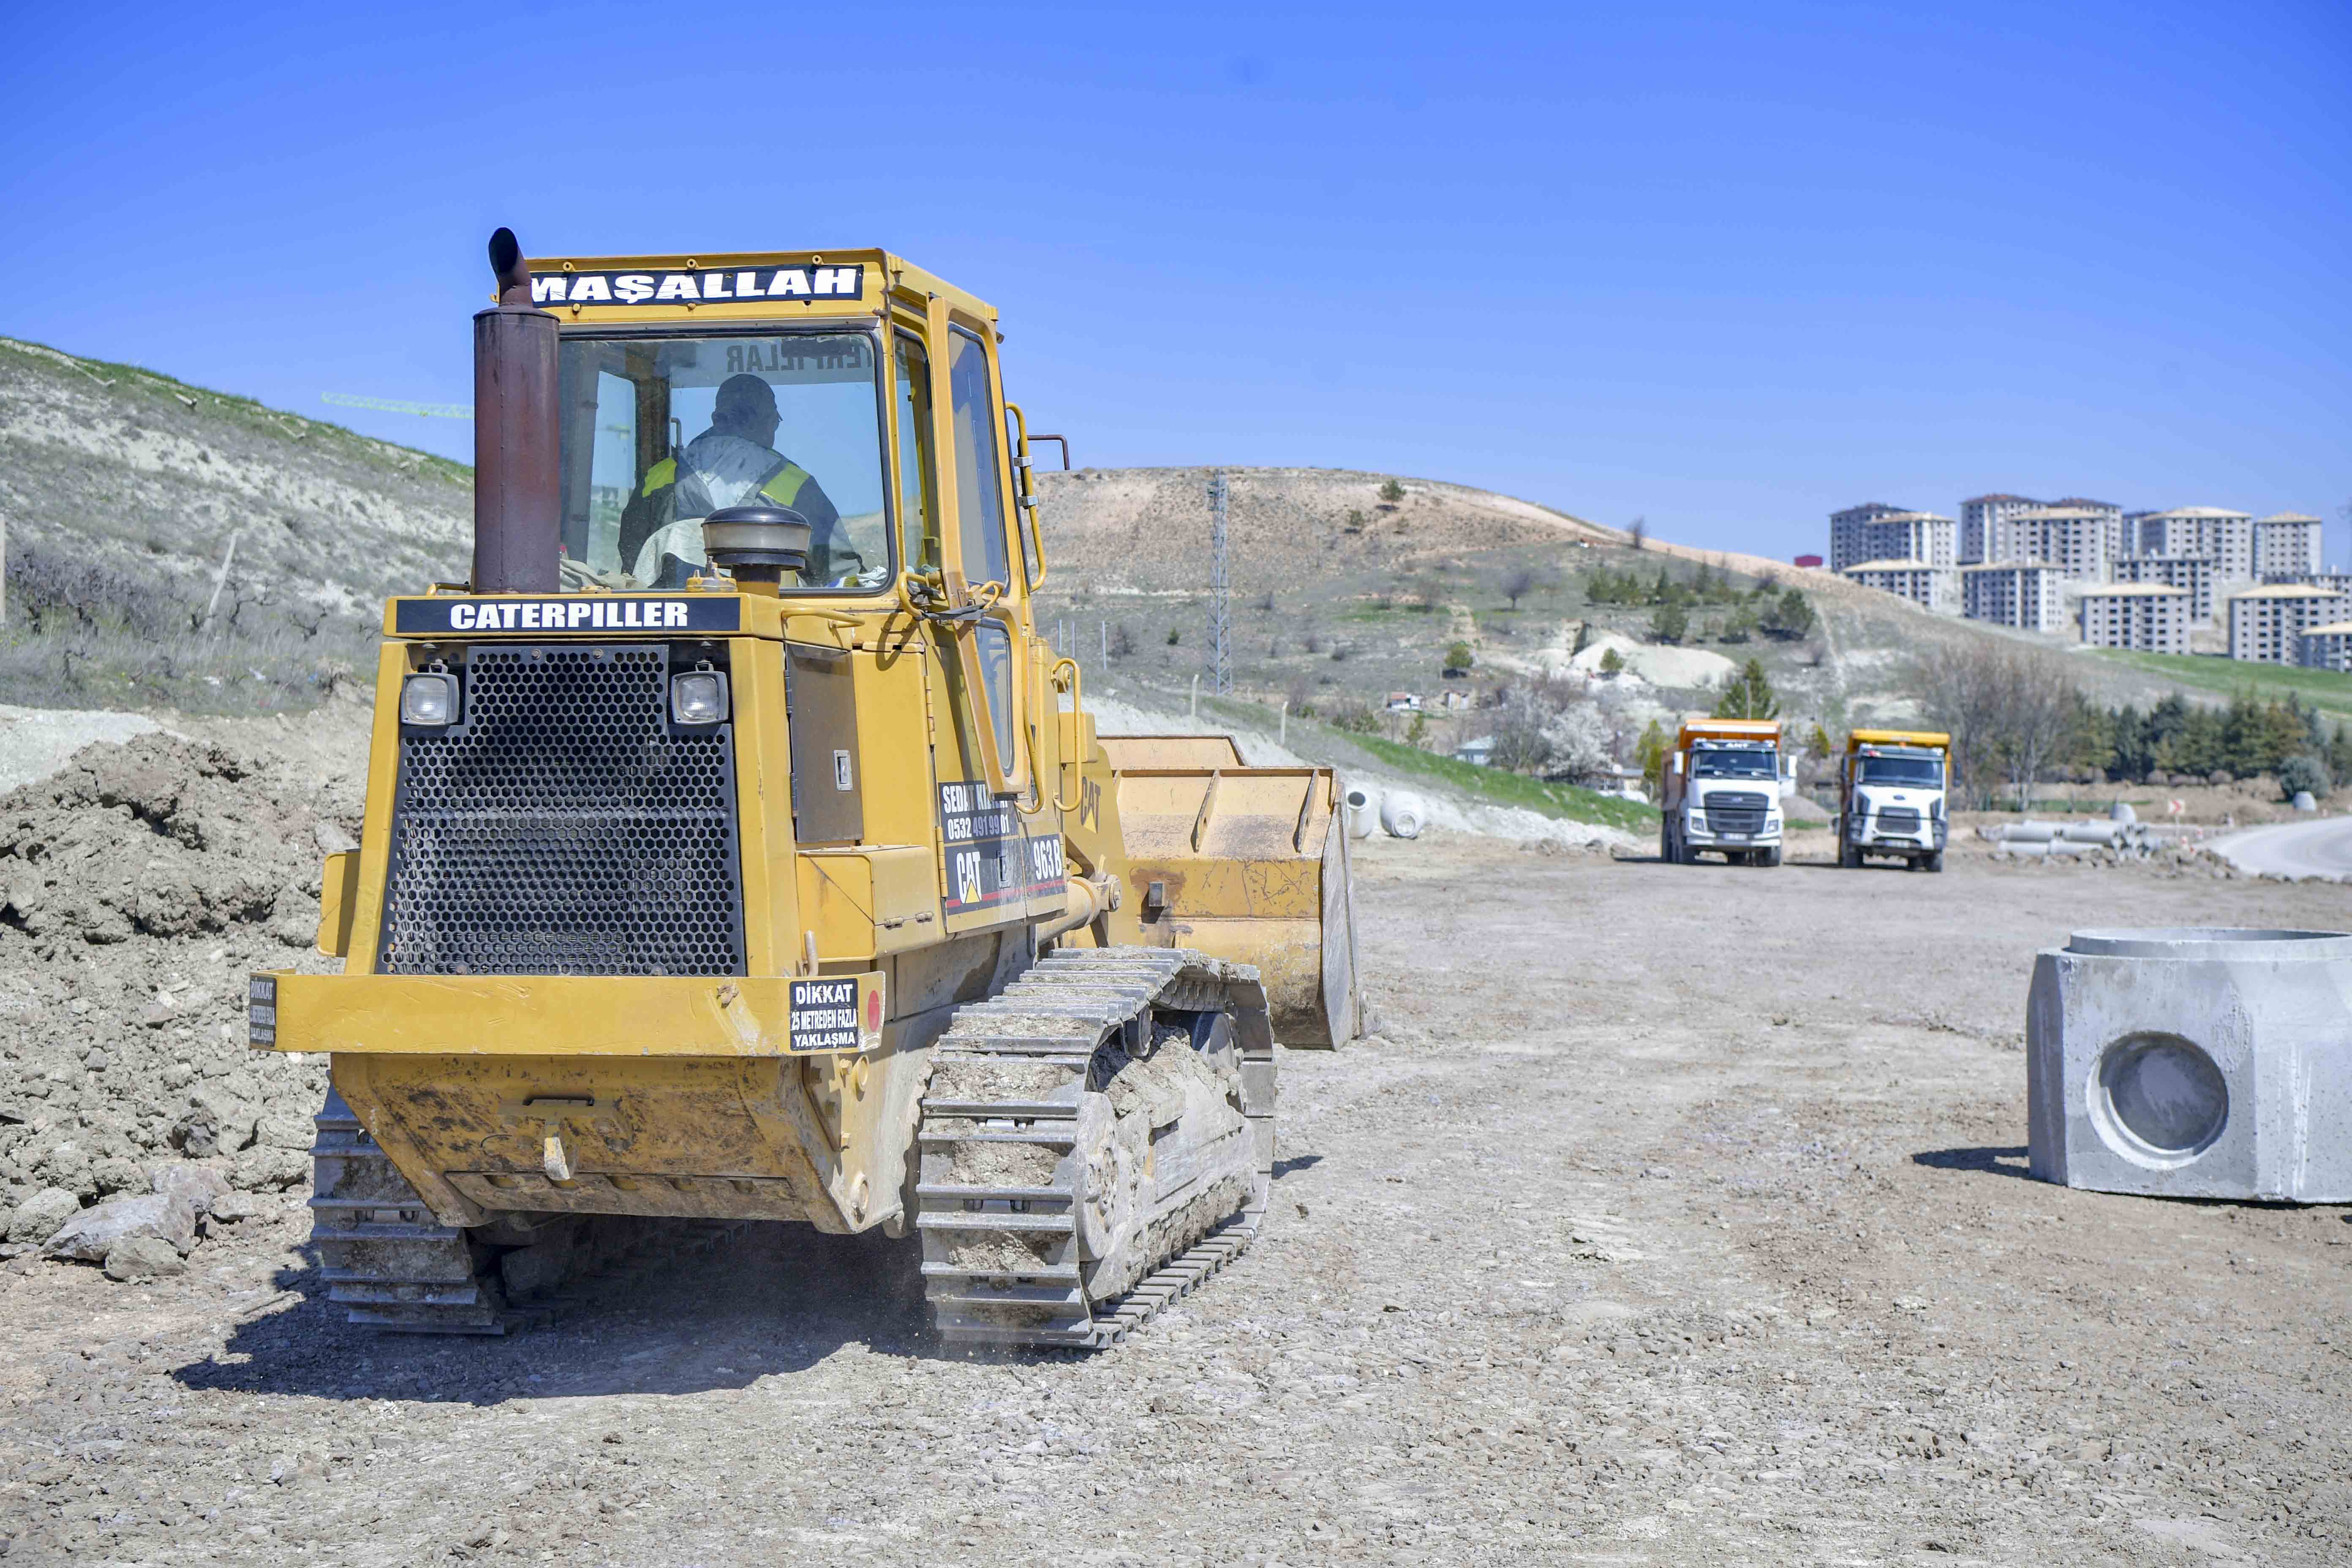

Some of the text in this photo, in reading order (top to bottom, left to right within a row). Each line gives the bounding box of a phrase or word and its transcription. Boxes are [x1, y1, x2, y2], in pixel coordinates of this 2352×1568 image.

[531, 269, 857, 304] MAŞALLAH
[450, 602, 688, 629] CATERPILLER
[942, 785, 975, 813] SEDAT
[1081, 776, 1101, 834] CAT
[947, 814, 1009, 840] 0532 491 99 01
[956, 852, 982, 904] CAT
[250, 976, 273, 1000] DİKKAT
[795, 982, 853, 1004] DİKKAT
[790, 1008, 857, 1031] 25 METREDEN FAZLA
[794, 1032, 855, 1048] YAKLAŞMA
